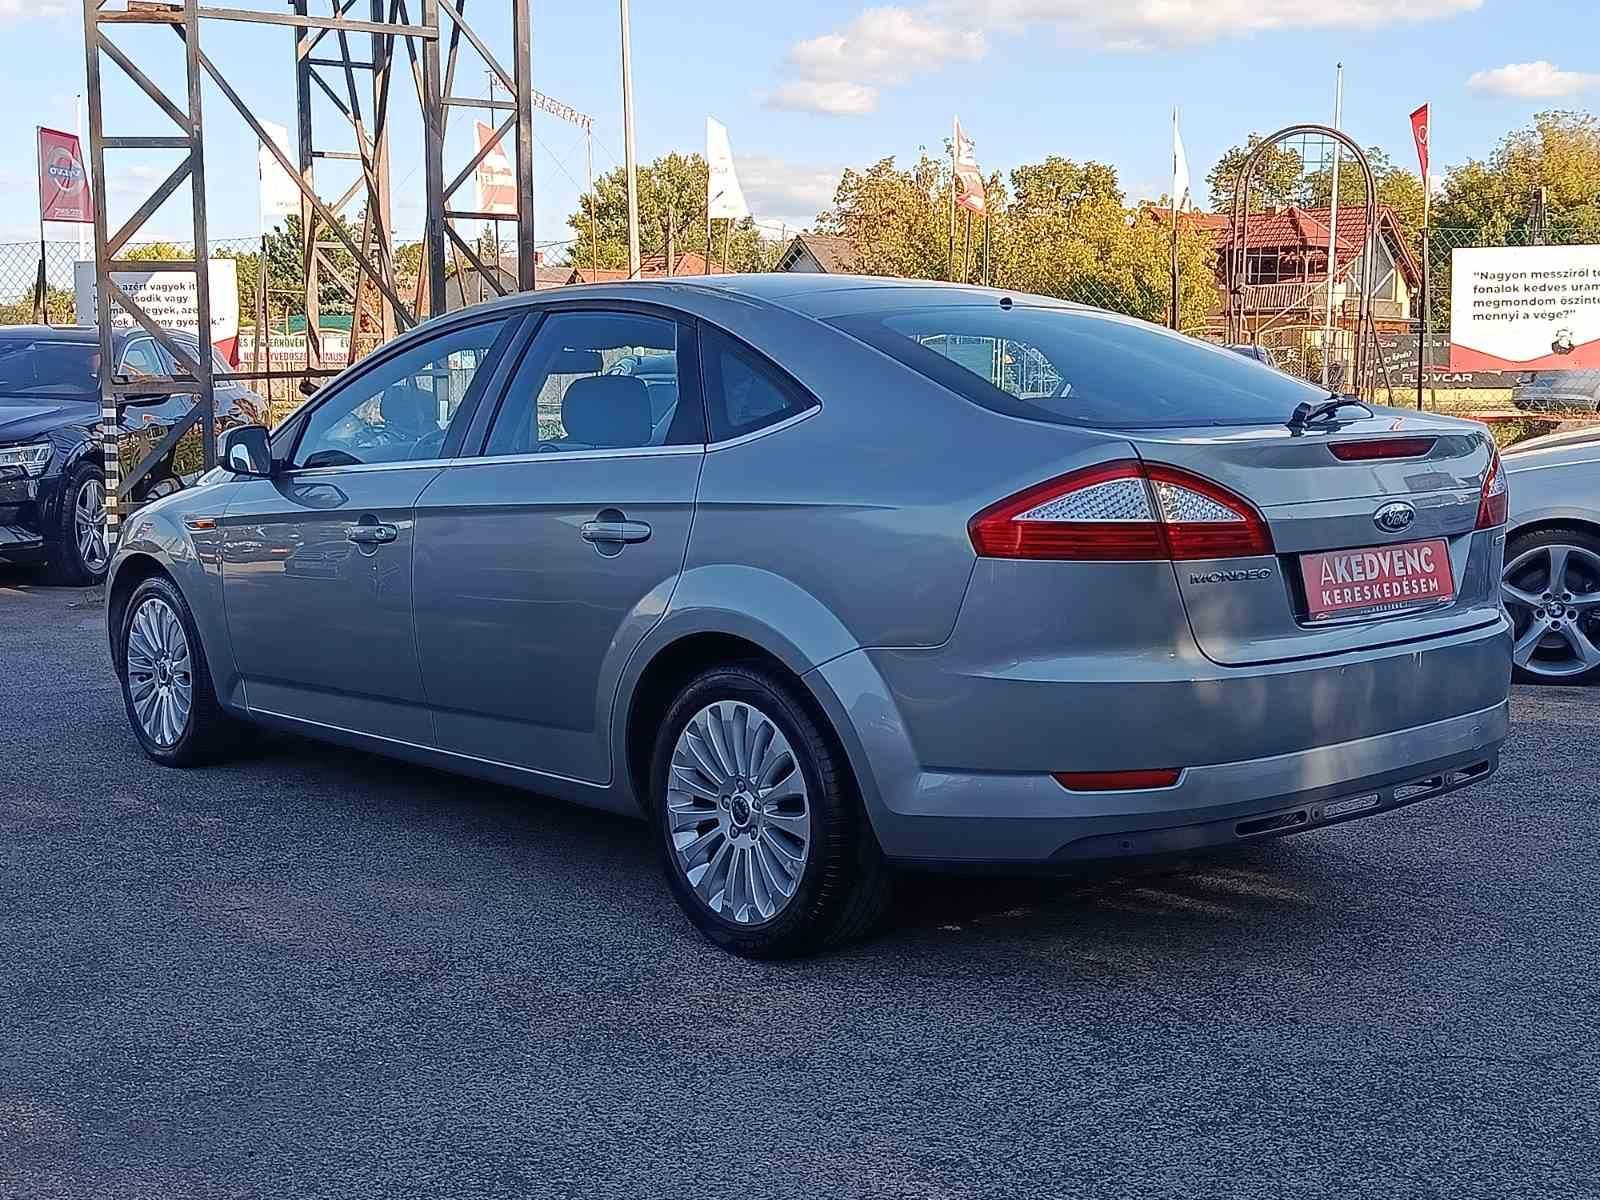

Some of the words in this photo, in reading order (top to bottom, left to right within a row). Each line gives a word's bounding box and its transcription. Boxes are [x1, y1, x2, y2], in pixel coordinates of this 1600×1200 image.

[150, 282, 186, 292] vagyok
[1523, 283, 1567, 292] kedves
[164, 295, 189, 304] vagy
[1473, 297, 1556, 309] megmondom
[1472, 310, 1520, 322] mennyi
[1522, 312, 1530, 320] a
[1189, 568, 1273, 585] MONDEO
[1322, 576, 1439, 606] KERESKEDÉSEM
